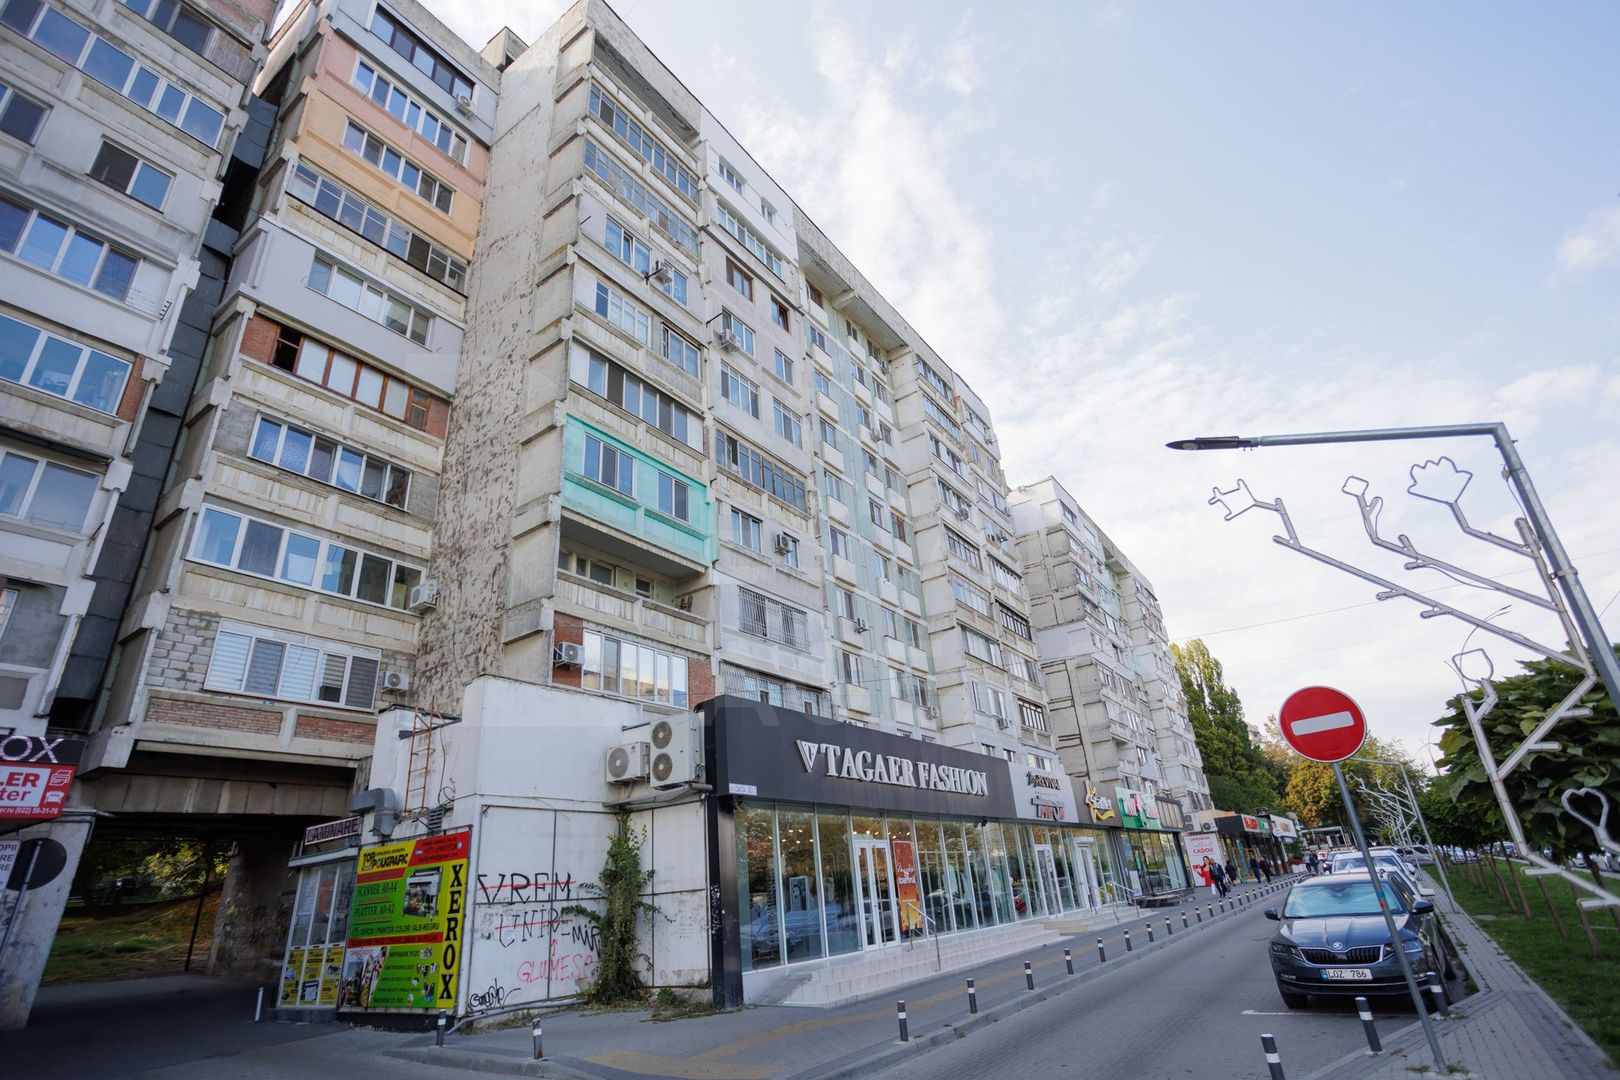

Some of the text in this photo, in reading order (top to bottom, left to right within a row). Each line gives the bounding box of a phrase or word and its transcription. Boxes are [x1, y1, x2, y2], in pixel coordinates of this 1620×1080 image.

[0, 772, 40, 788] ER
[916, 761, 989, 796] FASHION
[307, 818, 358, 842] LAMINARE
[439, 864, 464, 1000] XEROX
